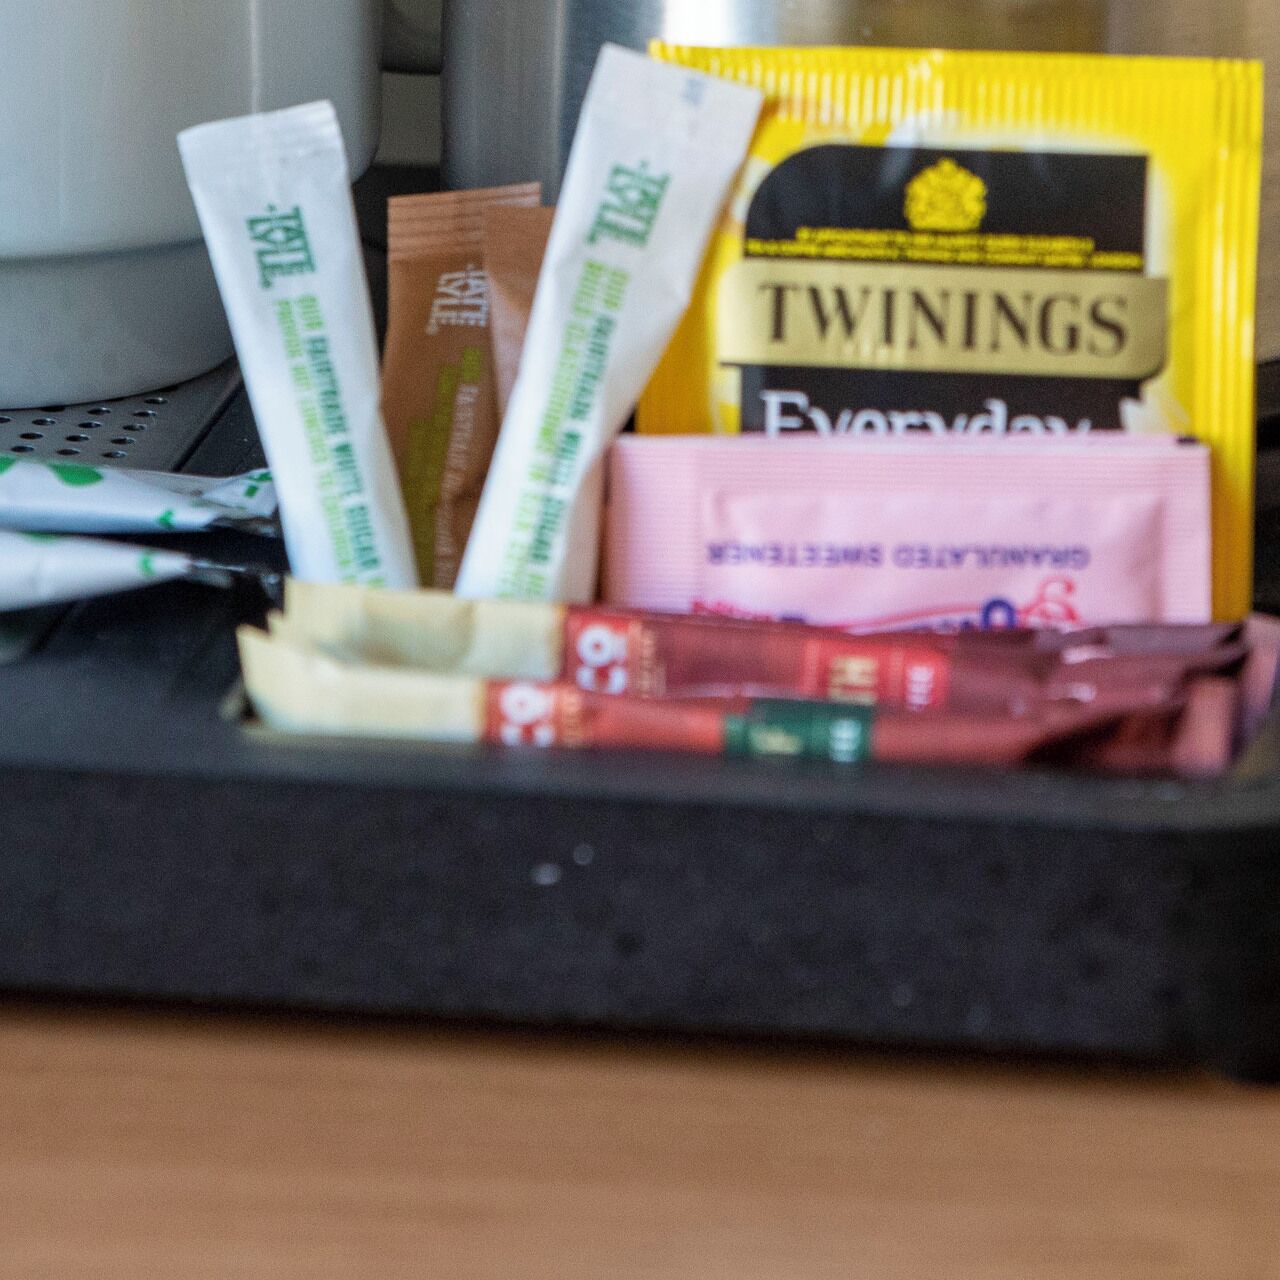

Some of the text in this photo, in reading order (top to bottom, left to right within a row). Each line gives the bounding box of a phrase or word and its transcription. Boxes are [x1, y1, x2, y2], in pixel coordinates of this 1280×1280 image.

[757, 282, 1130, 358] TWININGS
[707, 541, 1092, 570] GRANULATED SWEETENER
